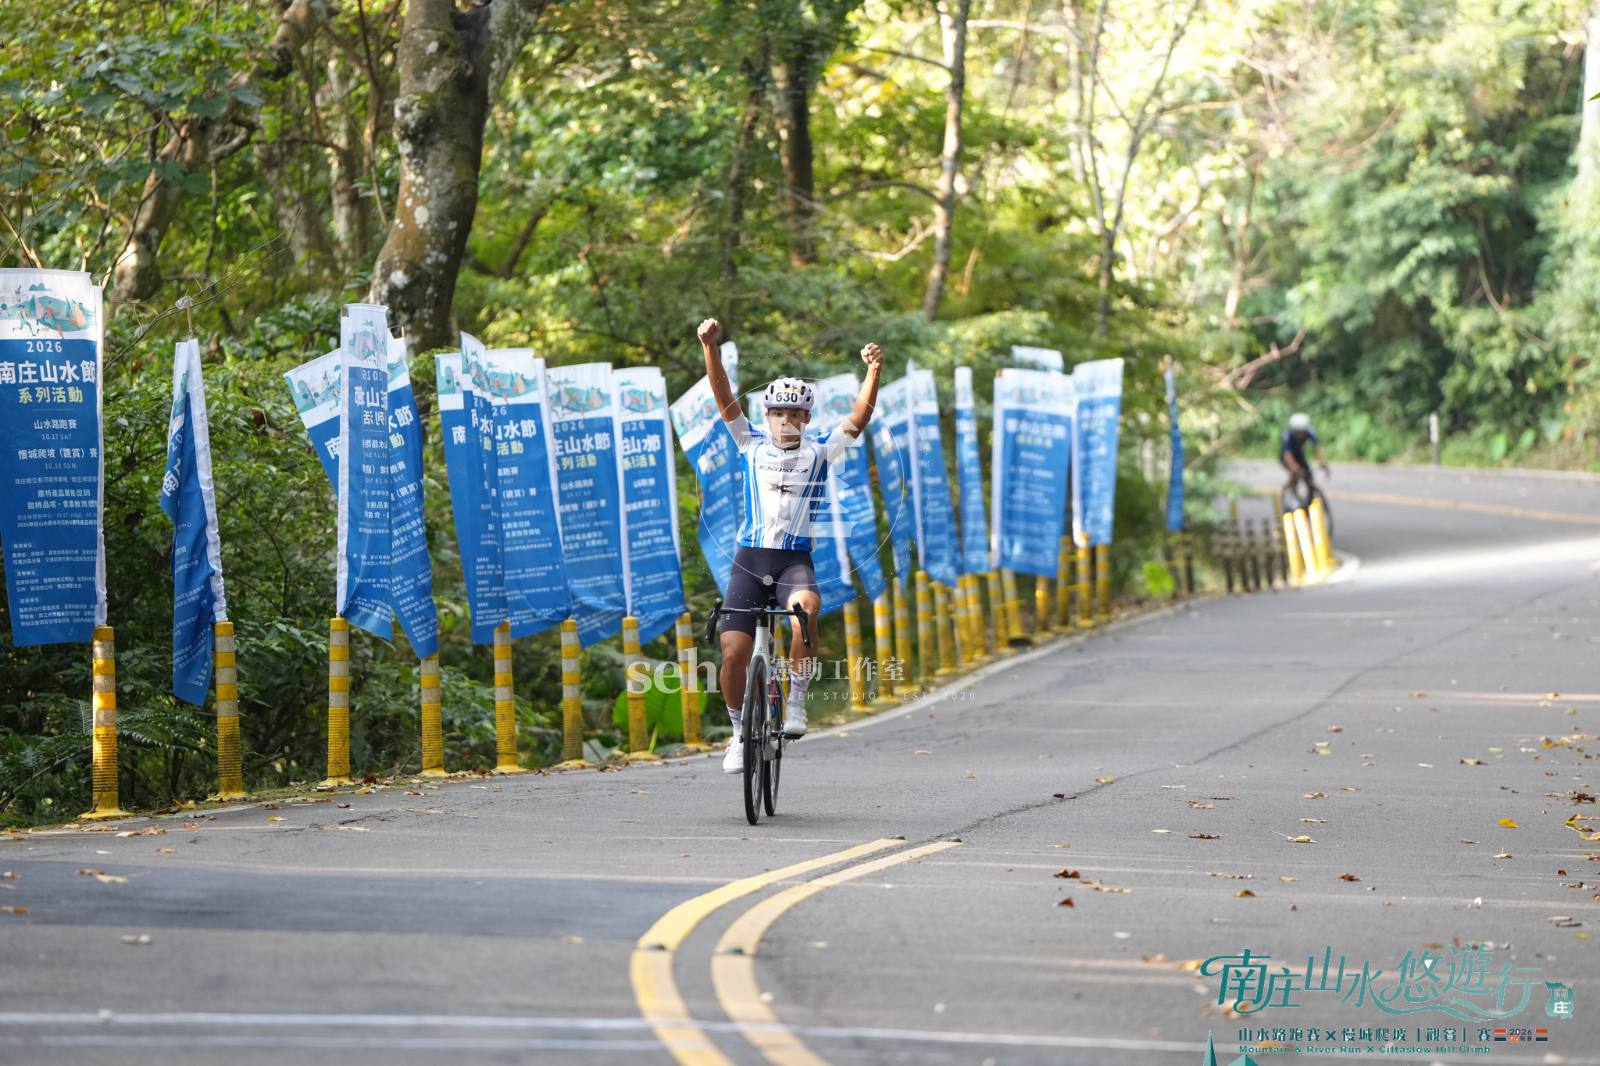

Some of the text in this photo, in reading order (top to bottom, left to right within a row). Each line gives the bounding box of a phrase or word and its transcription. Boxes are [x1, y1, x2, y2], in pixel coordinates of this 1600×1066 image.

[26, 340, 63, 353] 2026
[0, 359, 96, 385] 南庄山水節
[18, 386, 84, 404] 系列活動
[775, 391, 798, 403] 630
[34, 419, 77, 430] 山水路跑賽
[554, 421, 585, 433] 2026
